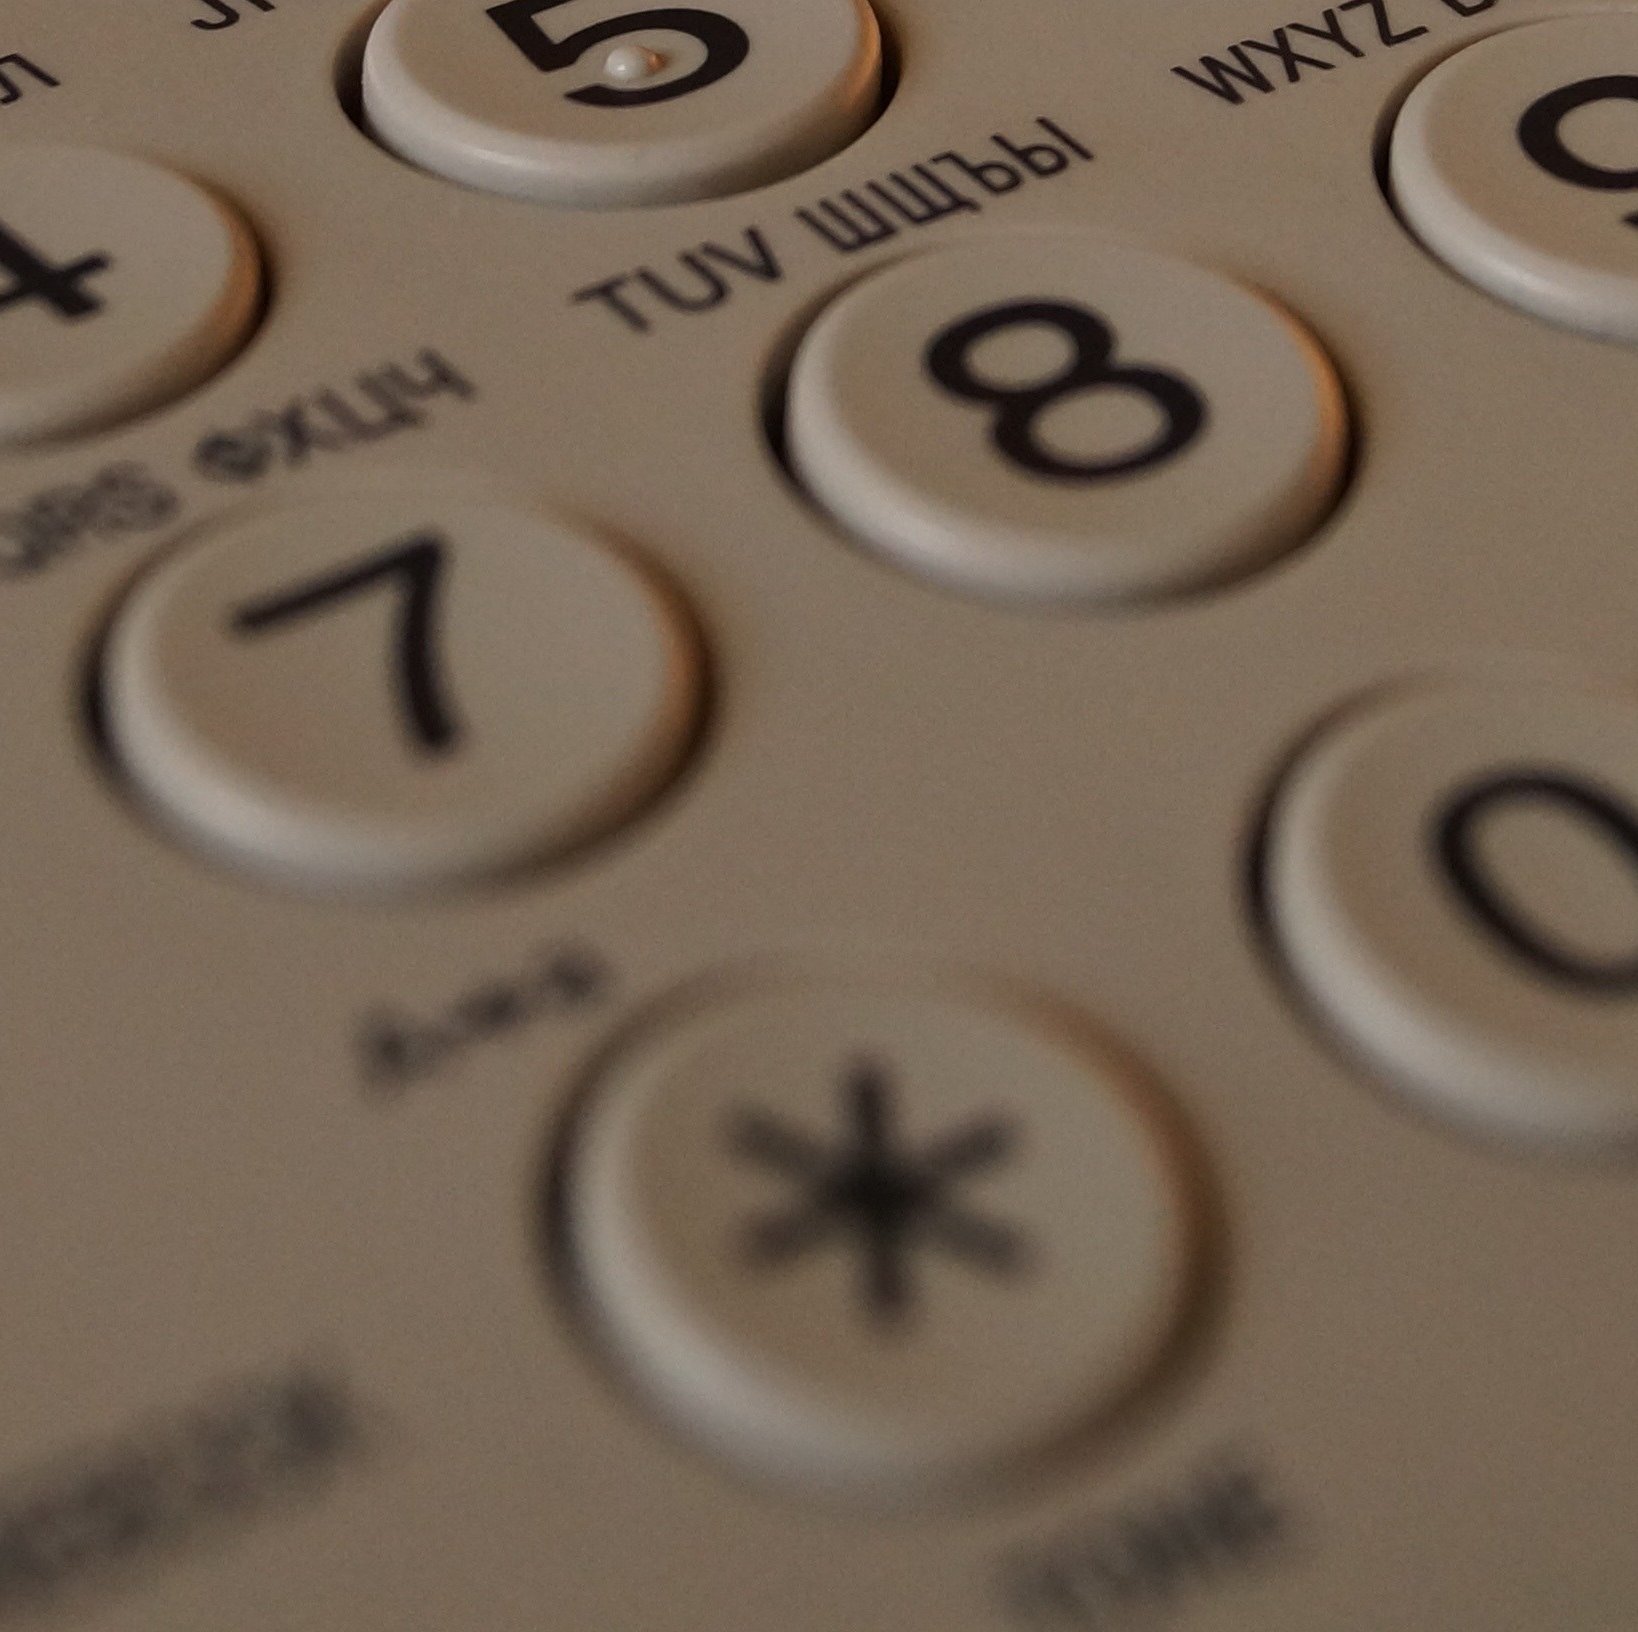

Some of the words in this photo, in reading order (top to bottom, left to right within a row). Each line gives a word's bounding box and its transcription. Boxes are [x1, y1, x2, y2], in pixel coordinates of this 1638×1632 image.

[571, 225, 783, 335] TUV
[795, 116, 1094, 254] ШЩЪЫ
[919, 294, 1212, 486] 8
[229, 530, 453, 760] 7
